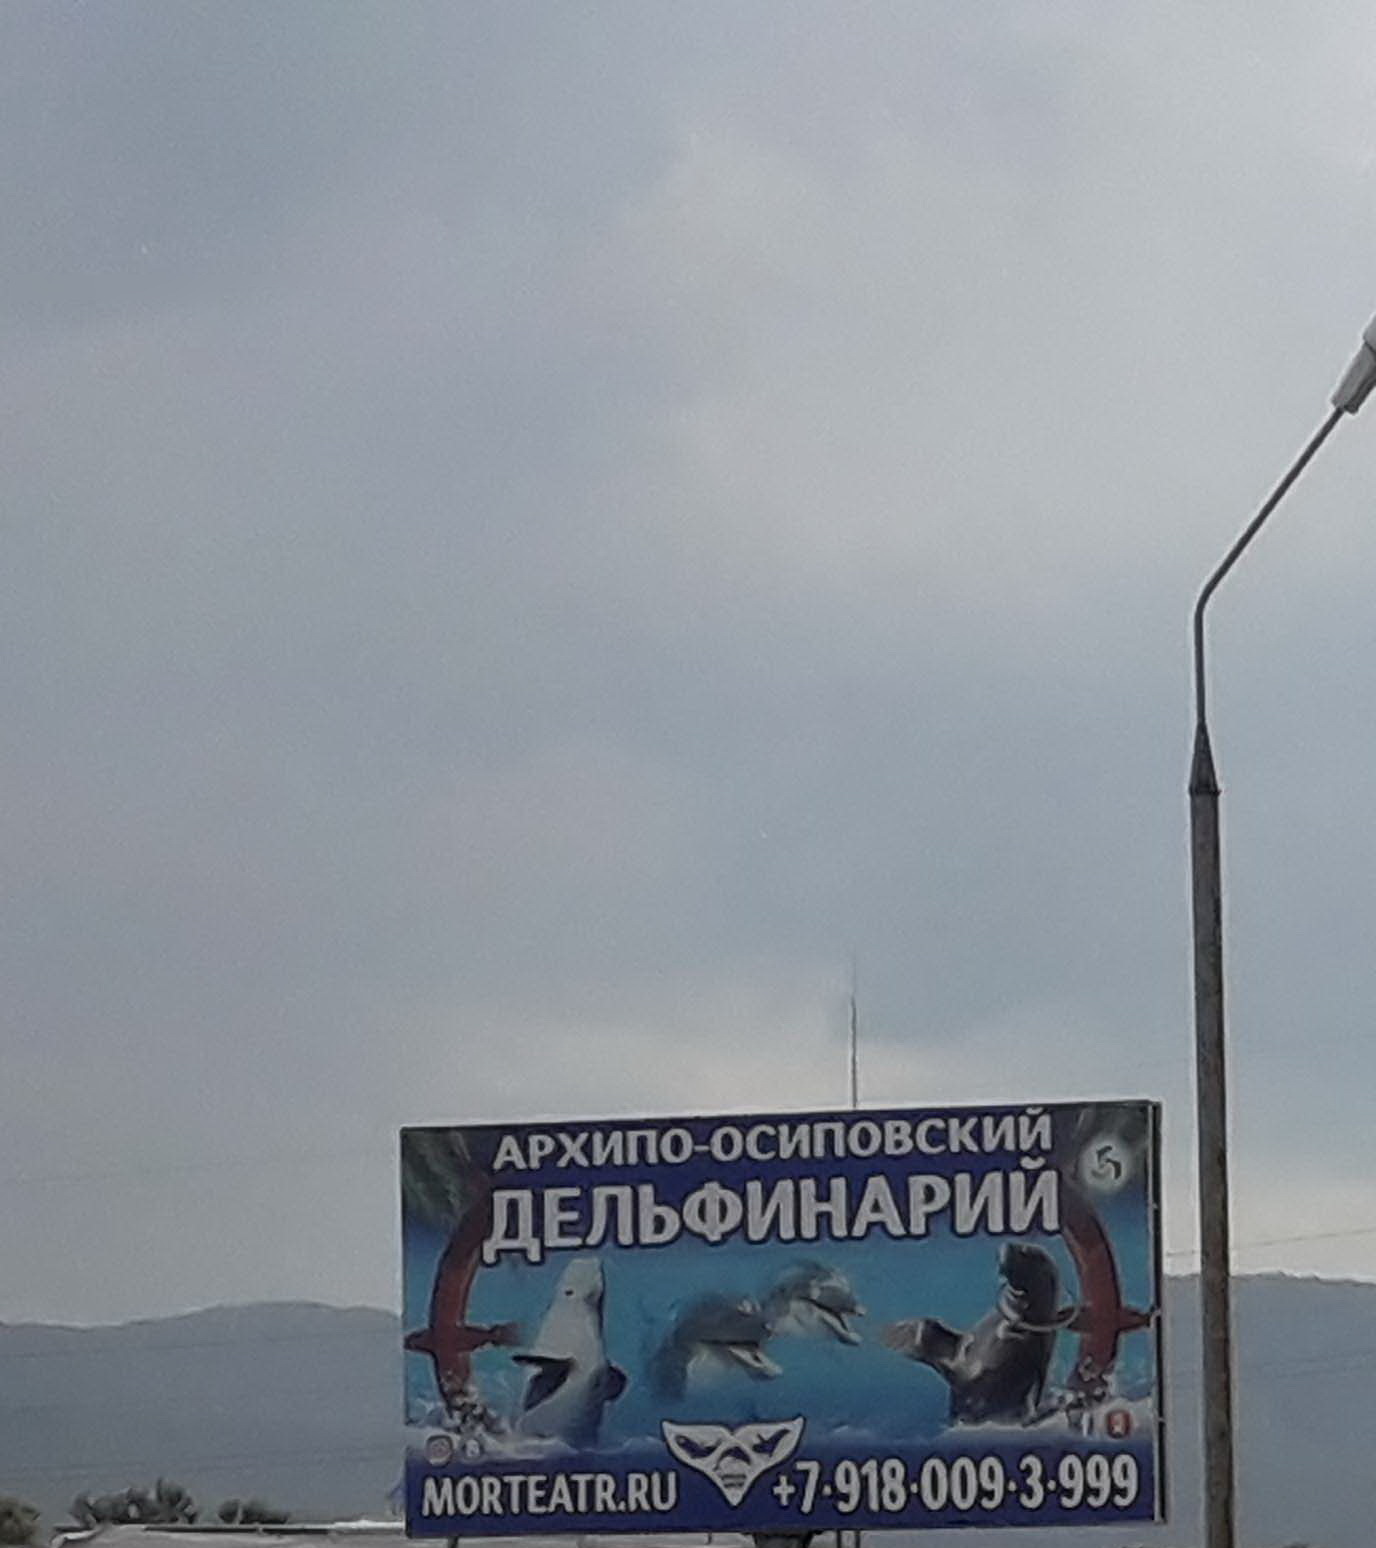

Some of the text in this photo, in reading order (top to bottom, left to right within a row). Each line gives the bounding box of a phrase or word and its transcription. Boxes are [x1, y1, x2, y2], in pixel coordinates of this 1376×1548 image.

[493, 1108, 1053, 1170] АРХИПО-ОСИПОВСКИЙ
[482, 1158, 1060, 1265] ДЕЛЬФИНАРИЙ
[421, 1470, 677, 1517] MORTEATR.RU
